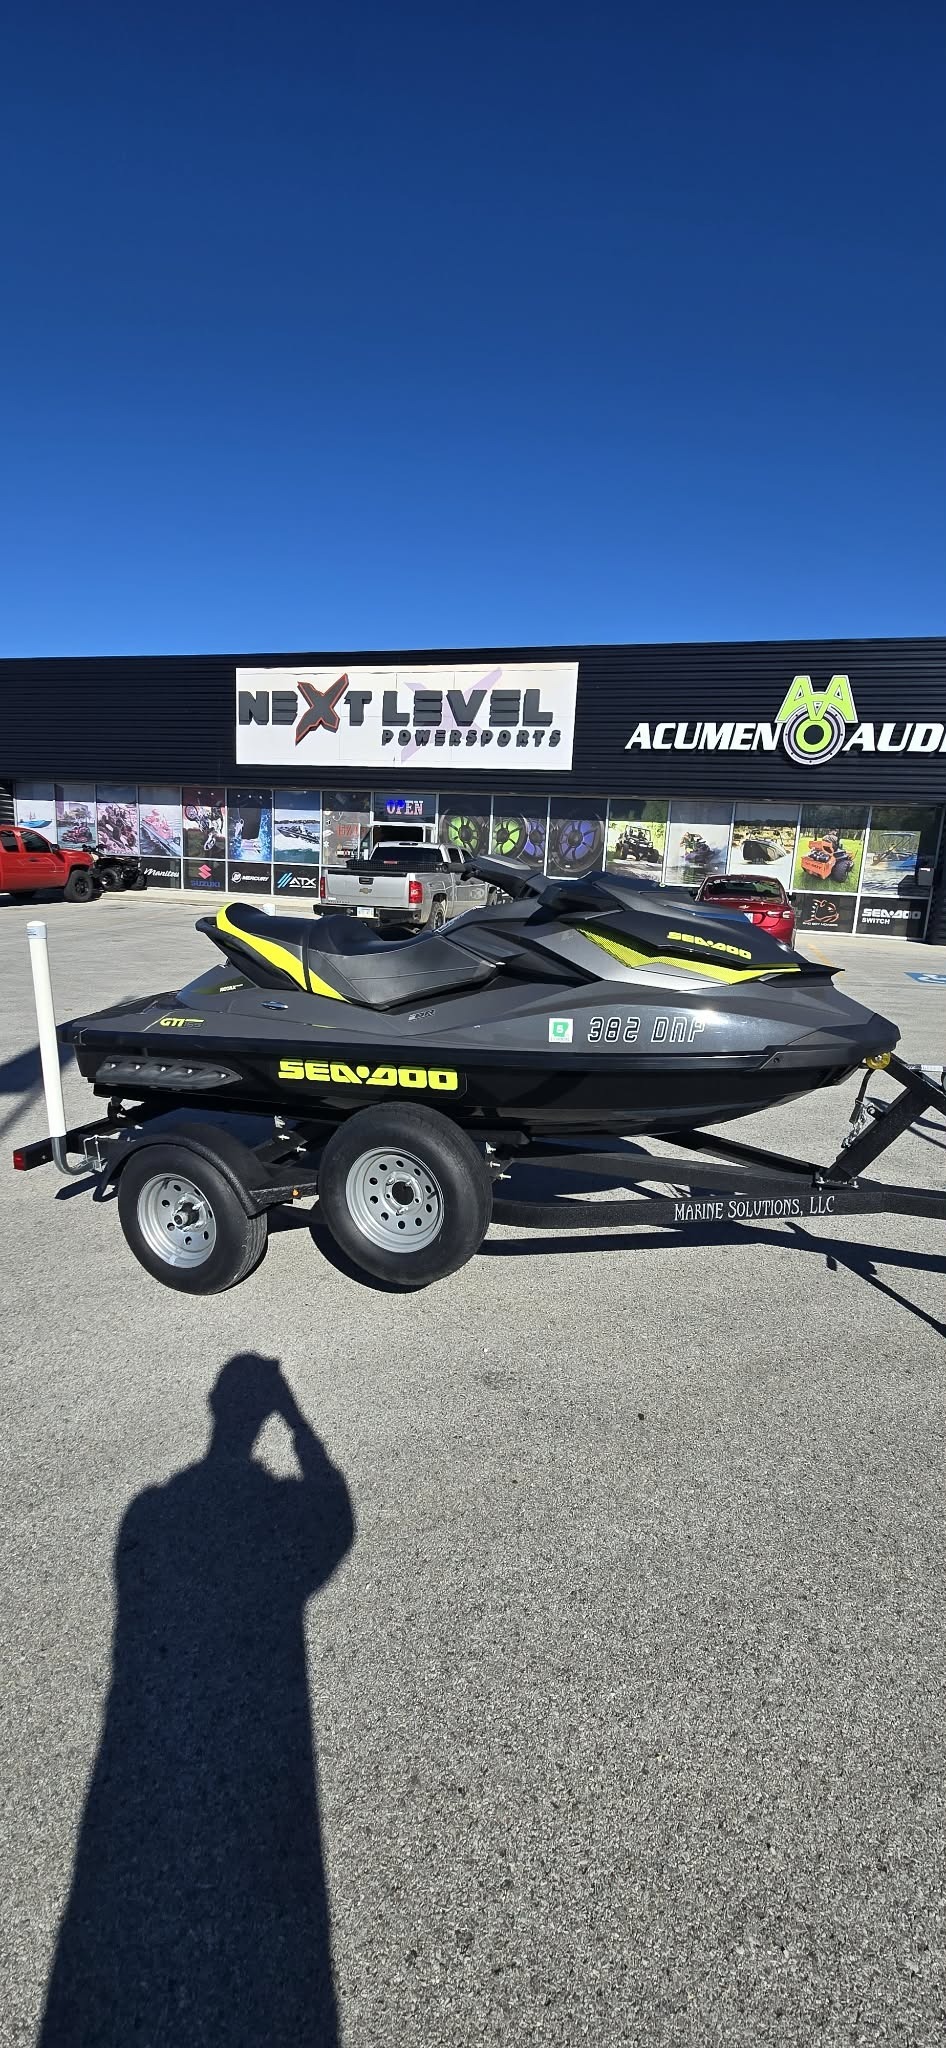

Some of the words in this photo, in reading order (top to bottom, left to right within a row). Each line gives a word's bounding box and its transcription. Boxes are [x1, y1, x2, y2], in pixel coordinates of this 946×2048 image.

[238, 673, 372, 746] NEXT
[382, 689, 553, 727] LEVEL
[382, 730, 561, 747] POWERSPORTS
[625, 722, 783, 750] ACUMEN
[386, 800, 423, 815] OPEN
[289, 877, 316, 886] ATX
[588, 1017, 640, 1043] 382
[674, 1203, 723, 1221] MARINE
[728, 1199, 803, 1218] SOLUTIONS,
[810, 1196, 835, 1214] LLC
